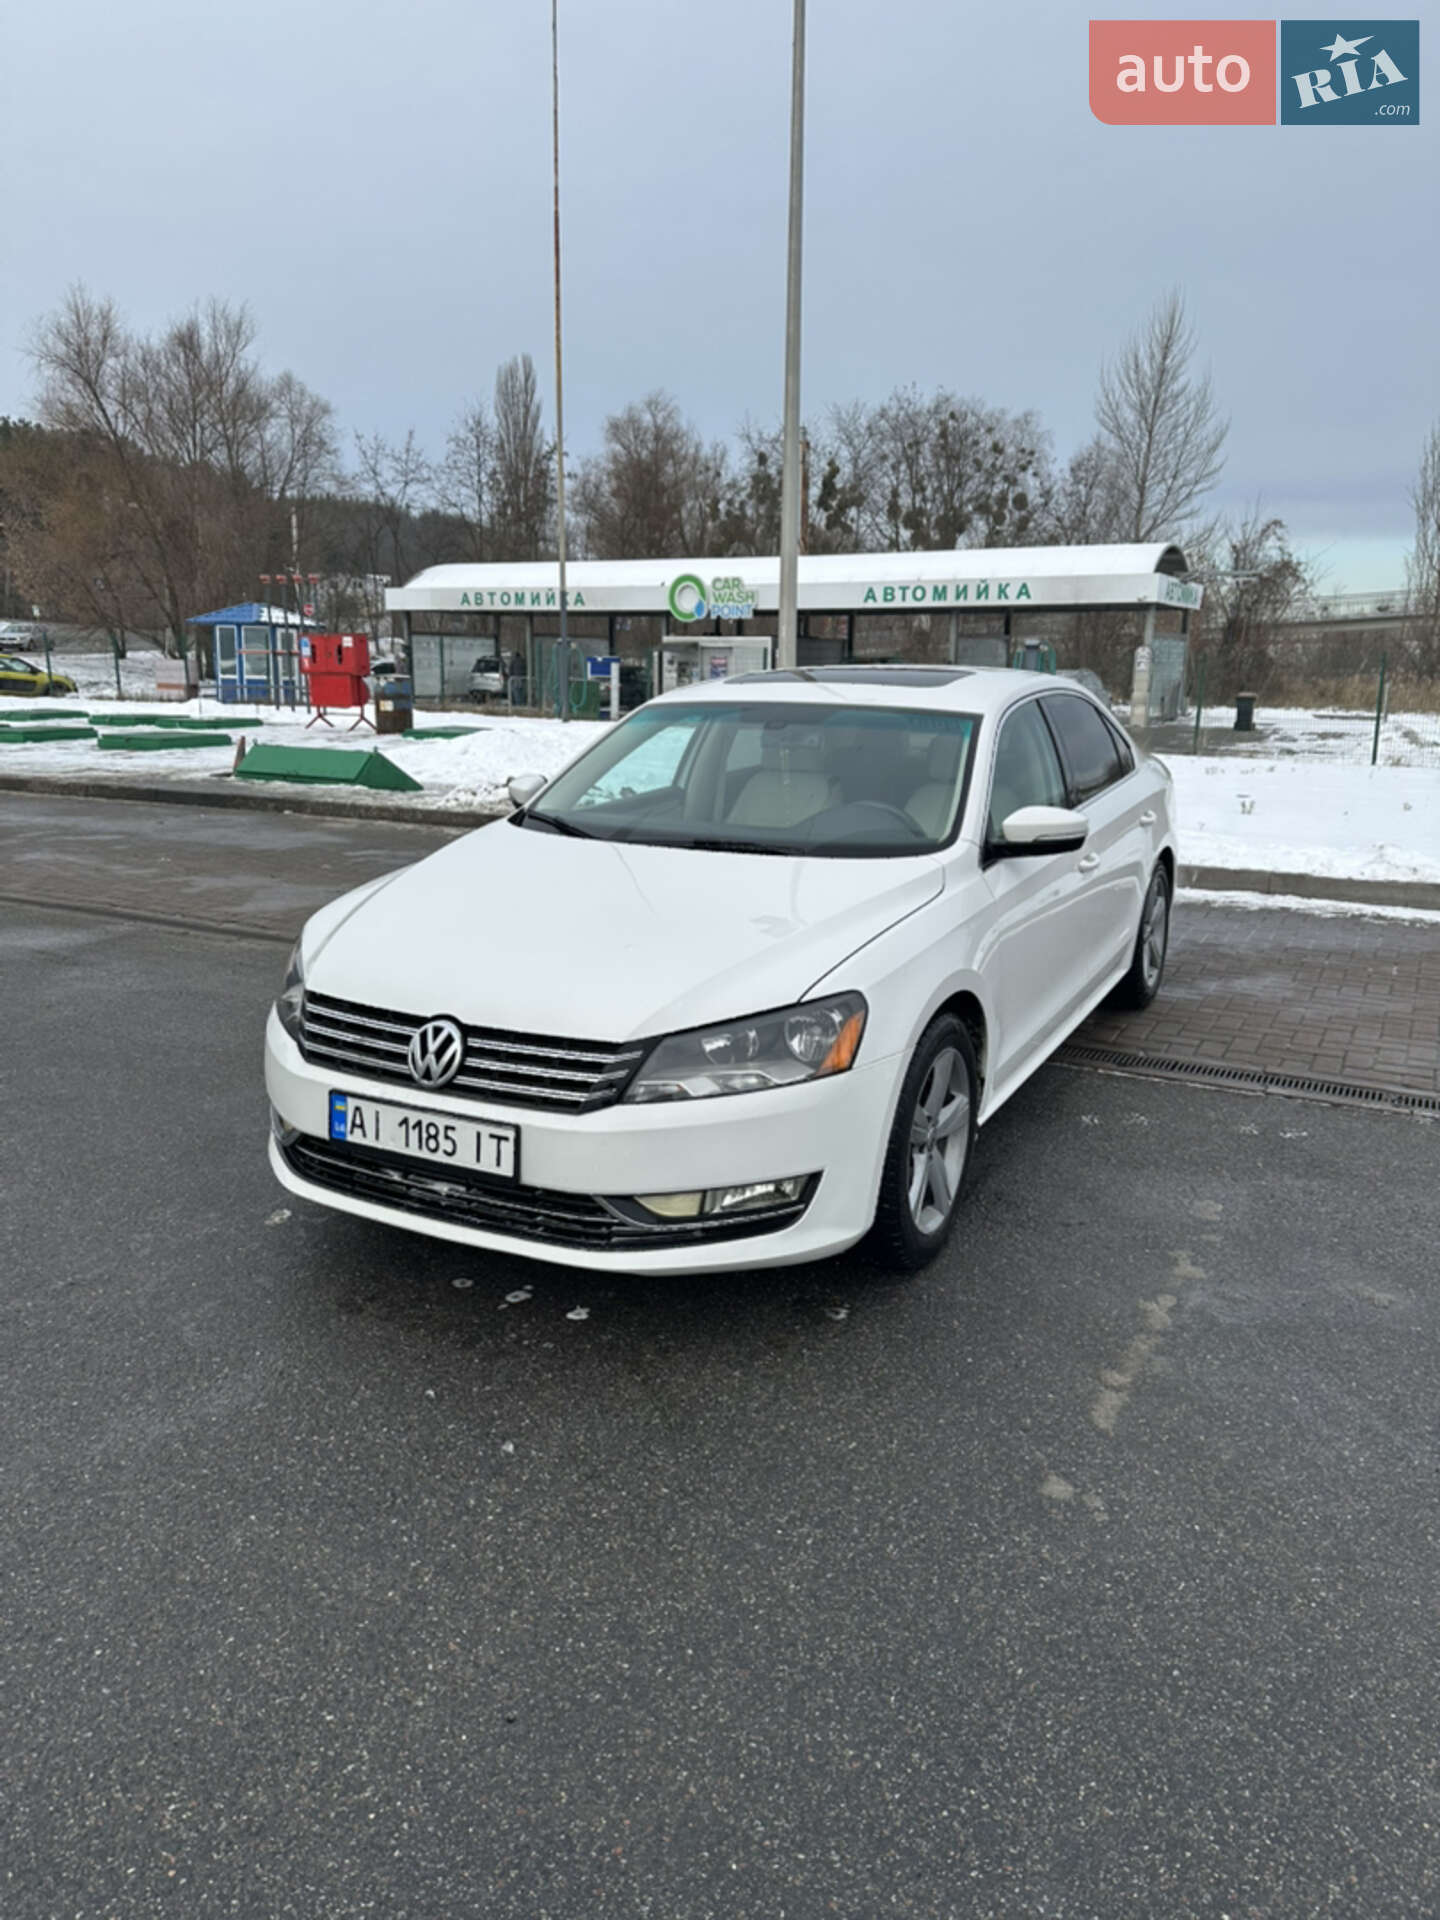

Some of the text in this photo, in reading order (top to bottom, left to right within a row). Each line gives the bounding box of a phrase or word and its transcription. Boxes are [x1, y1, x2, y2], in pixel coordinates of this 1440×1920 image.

[712, 577, 743, 591] CAR
[863, 579, 1032, 603] АВТОМИЙКА
[712, 591, 755, 603] WASH
[711, 604, 752, 618] POINT
[350, 1105, 511, 1168] AI 1185 IT
